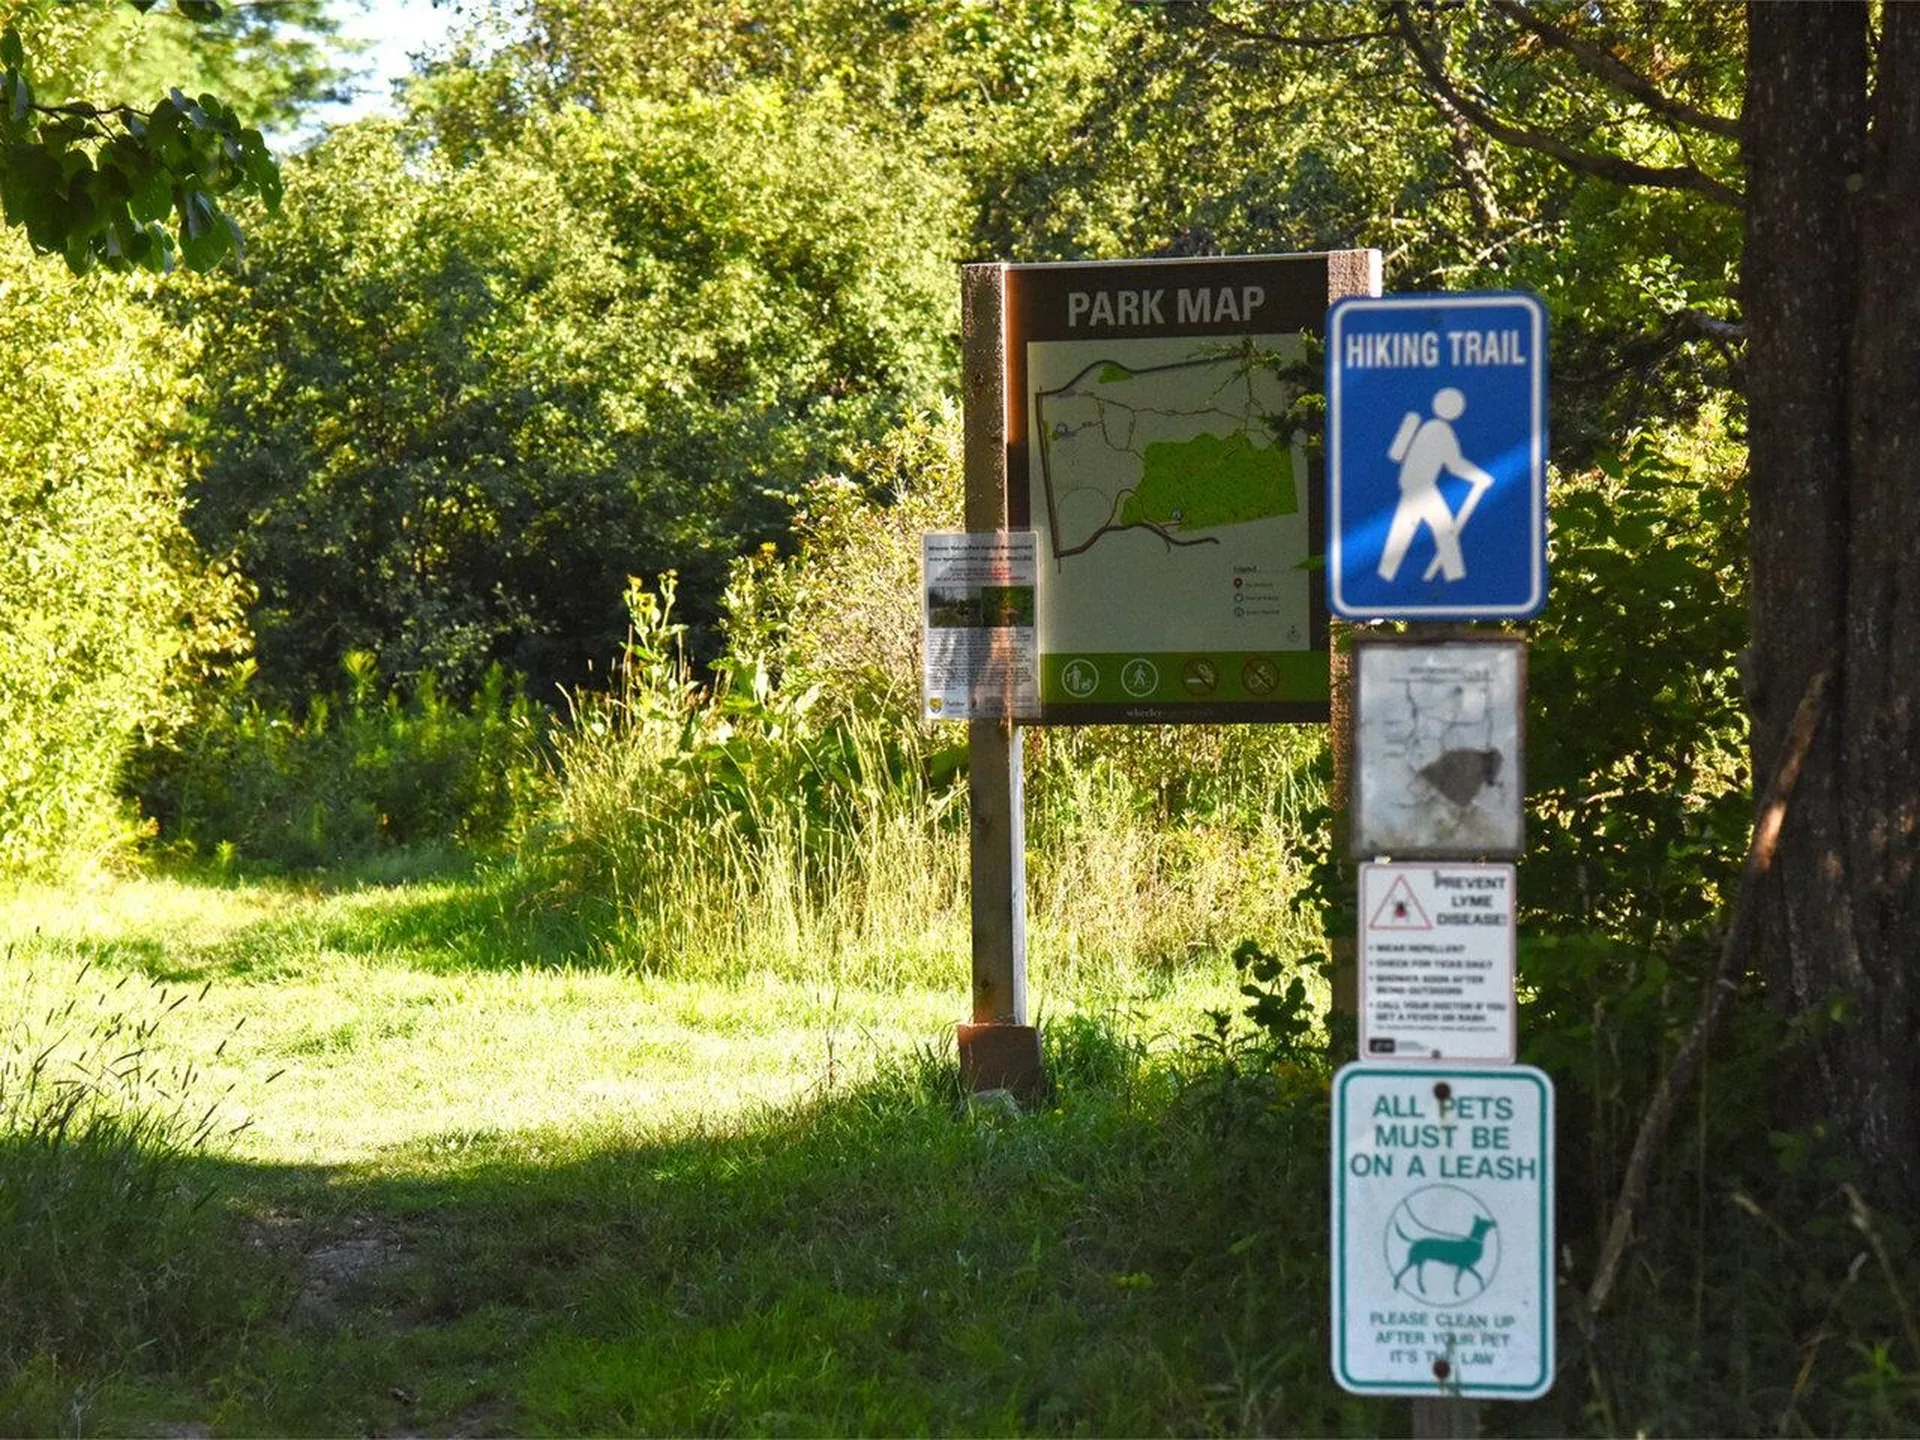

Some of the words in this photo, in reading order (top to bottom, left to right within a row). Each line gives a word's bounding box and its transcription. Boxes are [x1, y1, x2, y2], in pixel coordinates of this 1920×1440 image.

[1068, 289, 1165, 327] PARK
[1177, 286, 1265, 324] MAP
[1346, 331, 1439, 369] HIKING
[1447, 329, 1526, 366] TRAIL
[1434, 870, 1506, 889] PREVENT
[1451, 895, 1493, 908] LYME
[1376, 944, 1405, 952] WEAR
[1408, 944, 1465, 953] REPELLENT
[1376, 959, 1409, 968] CHECK
[1411, 960, 1431, 968] FOR
[1452, 975, 1485, 984] AFTER
[1376, 1001, 1400, 1009] CALL
[1403, 1001, 1429, 1010] YOUR
[1486, 1003, 1507, 1011] YOU
[1376, 1012, 1396, 1020] GET
[1407, 1013, 1439, 1021] FEVER
[1372, 1095, 1425, 1118] ALL
[1439, 1096, 1514, 1120] PETS
[1375, 1125, 1458, 1148] MUST
[1472, 1125, 1511, 1150] BE
[1350, 1153, 1393, 1177] ON
[1406, 1154, 1426, 1178] A
[1440, 1155, 1536, 1180] LEASH
[1369, 1311, 1428, 1326] PLEASE
[1435, 1312, 1488, 1328] CLEAN
[1493, 1314, 1516, 1329] UP
[1376, 1331, 1425, 1344] AFTER
[1481, 1333, 1511, 1347] PET
[1390, 1349, 1418, 1363] IT'S
[1461, 1351, 1494, 1365] LAW
